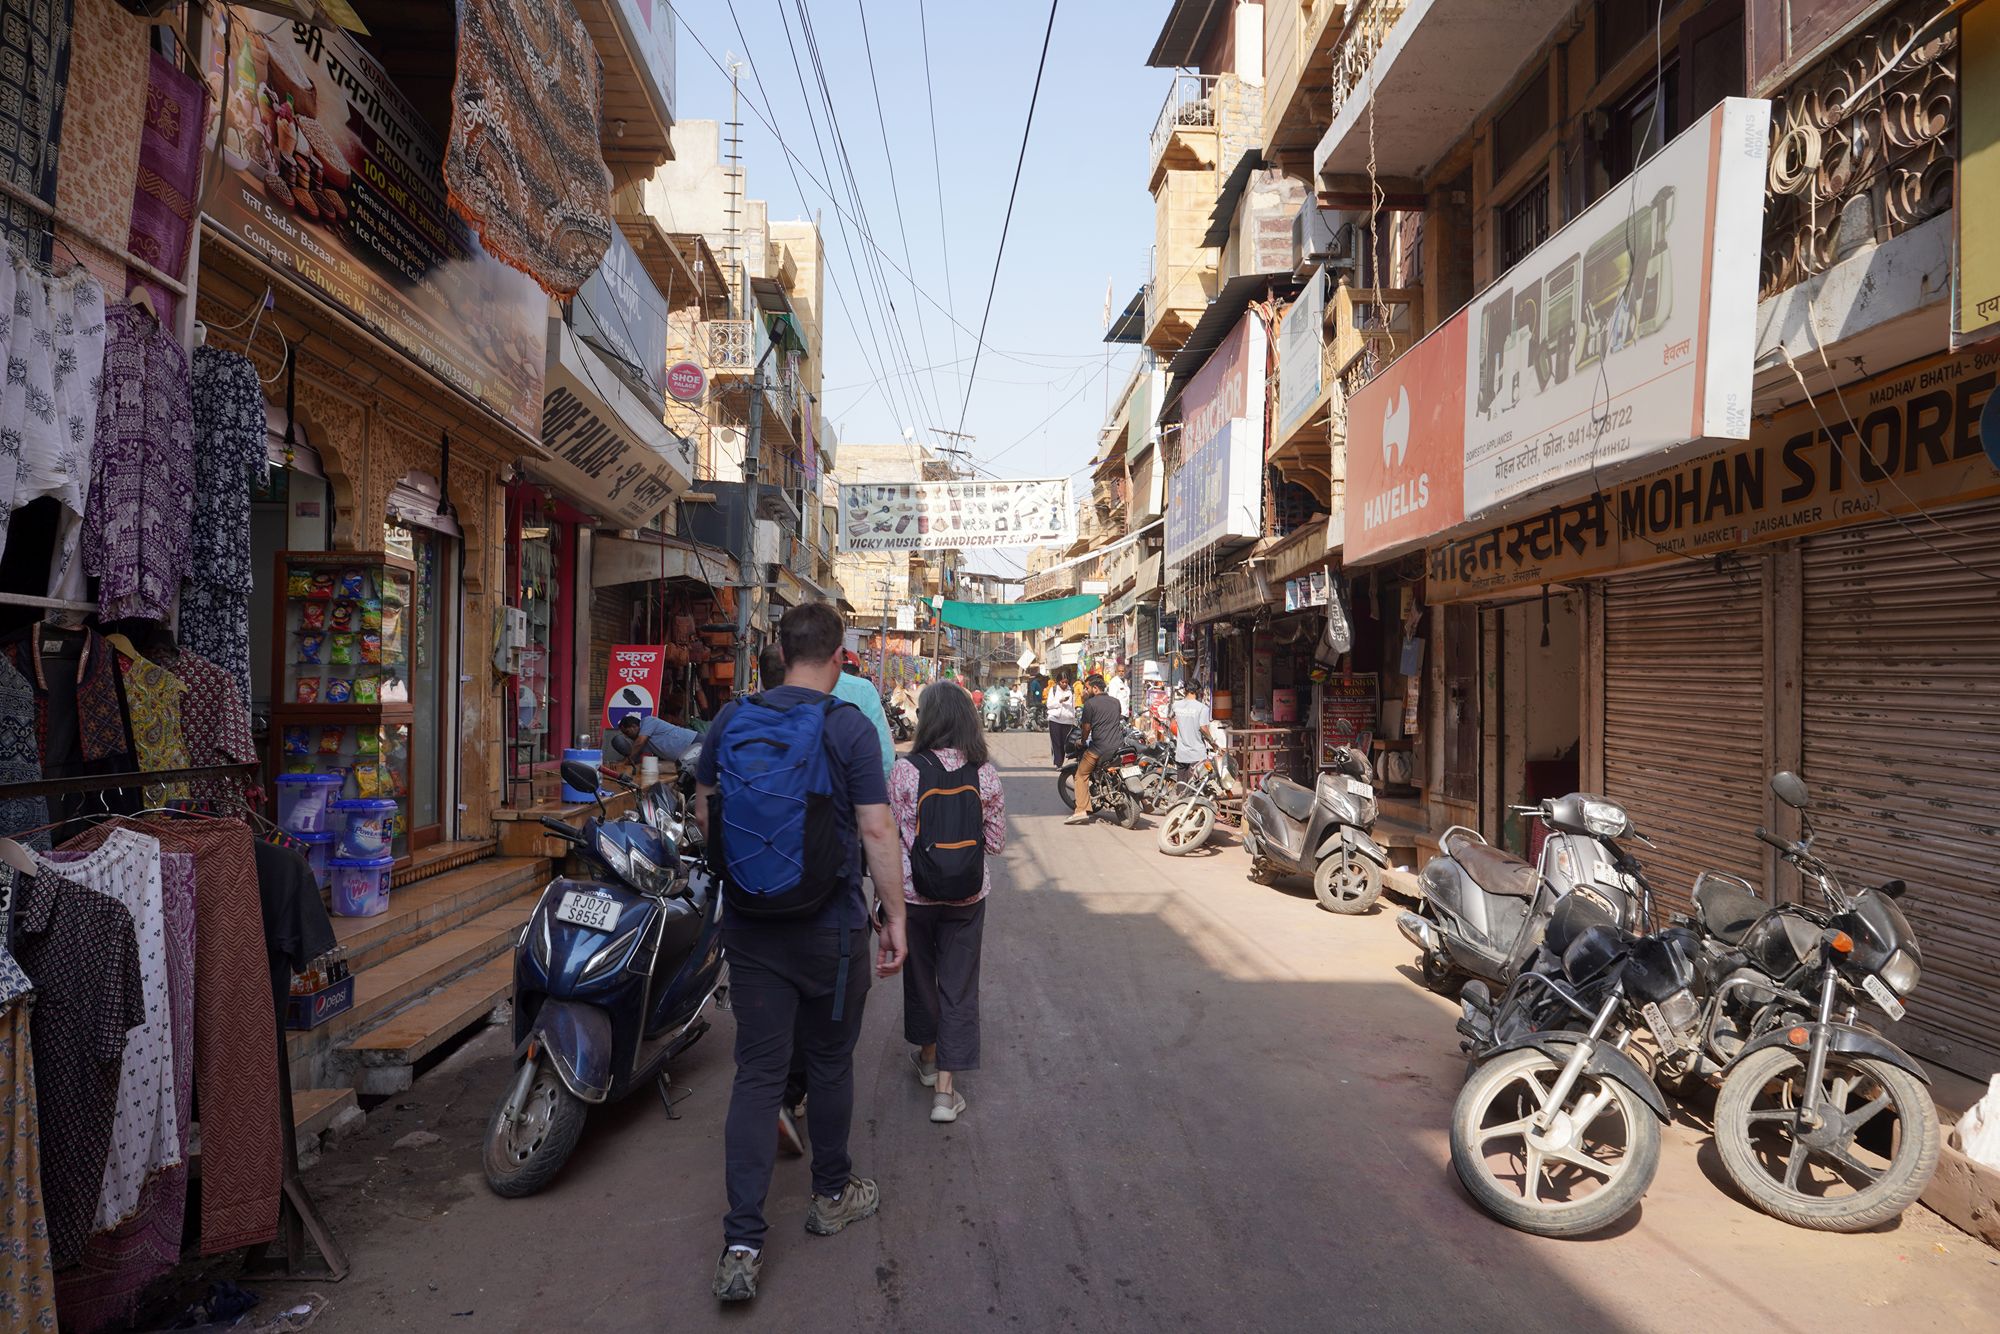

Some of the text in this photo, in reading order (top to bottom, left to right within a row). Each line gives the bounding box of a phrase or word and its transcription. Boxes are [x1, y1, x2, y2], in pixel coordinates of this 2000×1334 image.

[1744, 114, 1756, 158] AM/NS
[1753, 129, 1764, 159] INDIA
[363, 158, 386, 189] 100
[375, 138, 438, 210] PROVISION
[356, 204, 426, 271] Atta, Rice & Spices
[357, 184, 389, 221] General
[390, 214, 431, 258] Households
[242, 189, 262, 213] पता
[264, 205, 297, 238] Sadar
[300, 232, 338, 271] Bazaar,
[340, 261, 369, 292] Bhatia
[401, 310, 427, 338] Opposite
[355, 222, 449, 309] Ice Cream & Cold Drinks
[244, 224, 292, 267] Contact:
[295, 254, 351, 305] Vishwas
[354, 295, 388, 334] Manoj
[420, 344, 472, 390] 7014703309
[672, 373, 700, 384] SHOE
[674, 381, 696, 390] PALACE
[1869, 376, 1917, 406] MADHAV
[483, 385, 511, 414] Delivery
[1193, 371, 1242, 442] ANCHOR
[554, 416, 631, 479] PALACE
[1621, 372, 1997, 542] MOHAN STORE
[1495, 457, 1515, 480] मोहन
[1363, 472, 1430, 531] HAVELLS
[850, 533, 1039, 549] VICKY MUSIC & HANDICRAFT SHOP
[1656, 537, 1686, 554] BHATIA
[1694, 526, 1738, 546] MARKET
[1752, 507, 1822, 535] JAISALMER
[616, 651, 658, 667] स्कूल
[583, 891, 613, 900] HONDA
[568, 908, 606, 928] S8554
[325, 987, 347, 1012] pepsi
